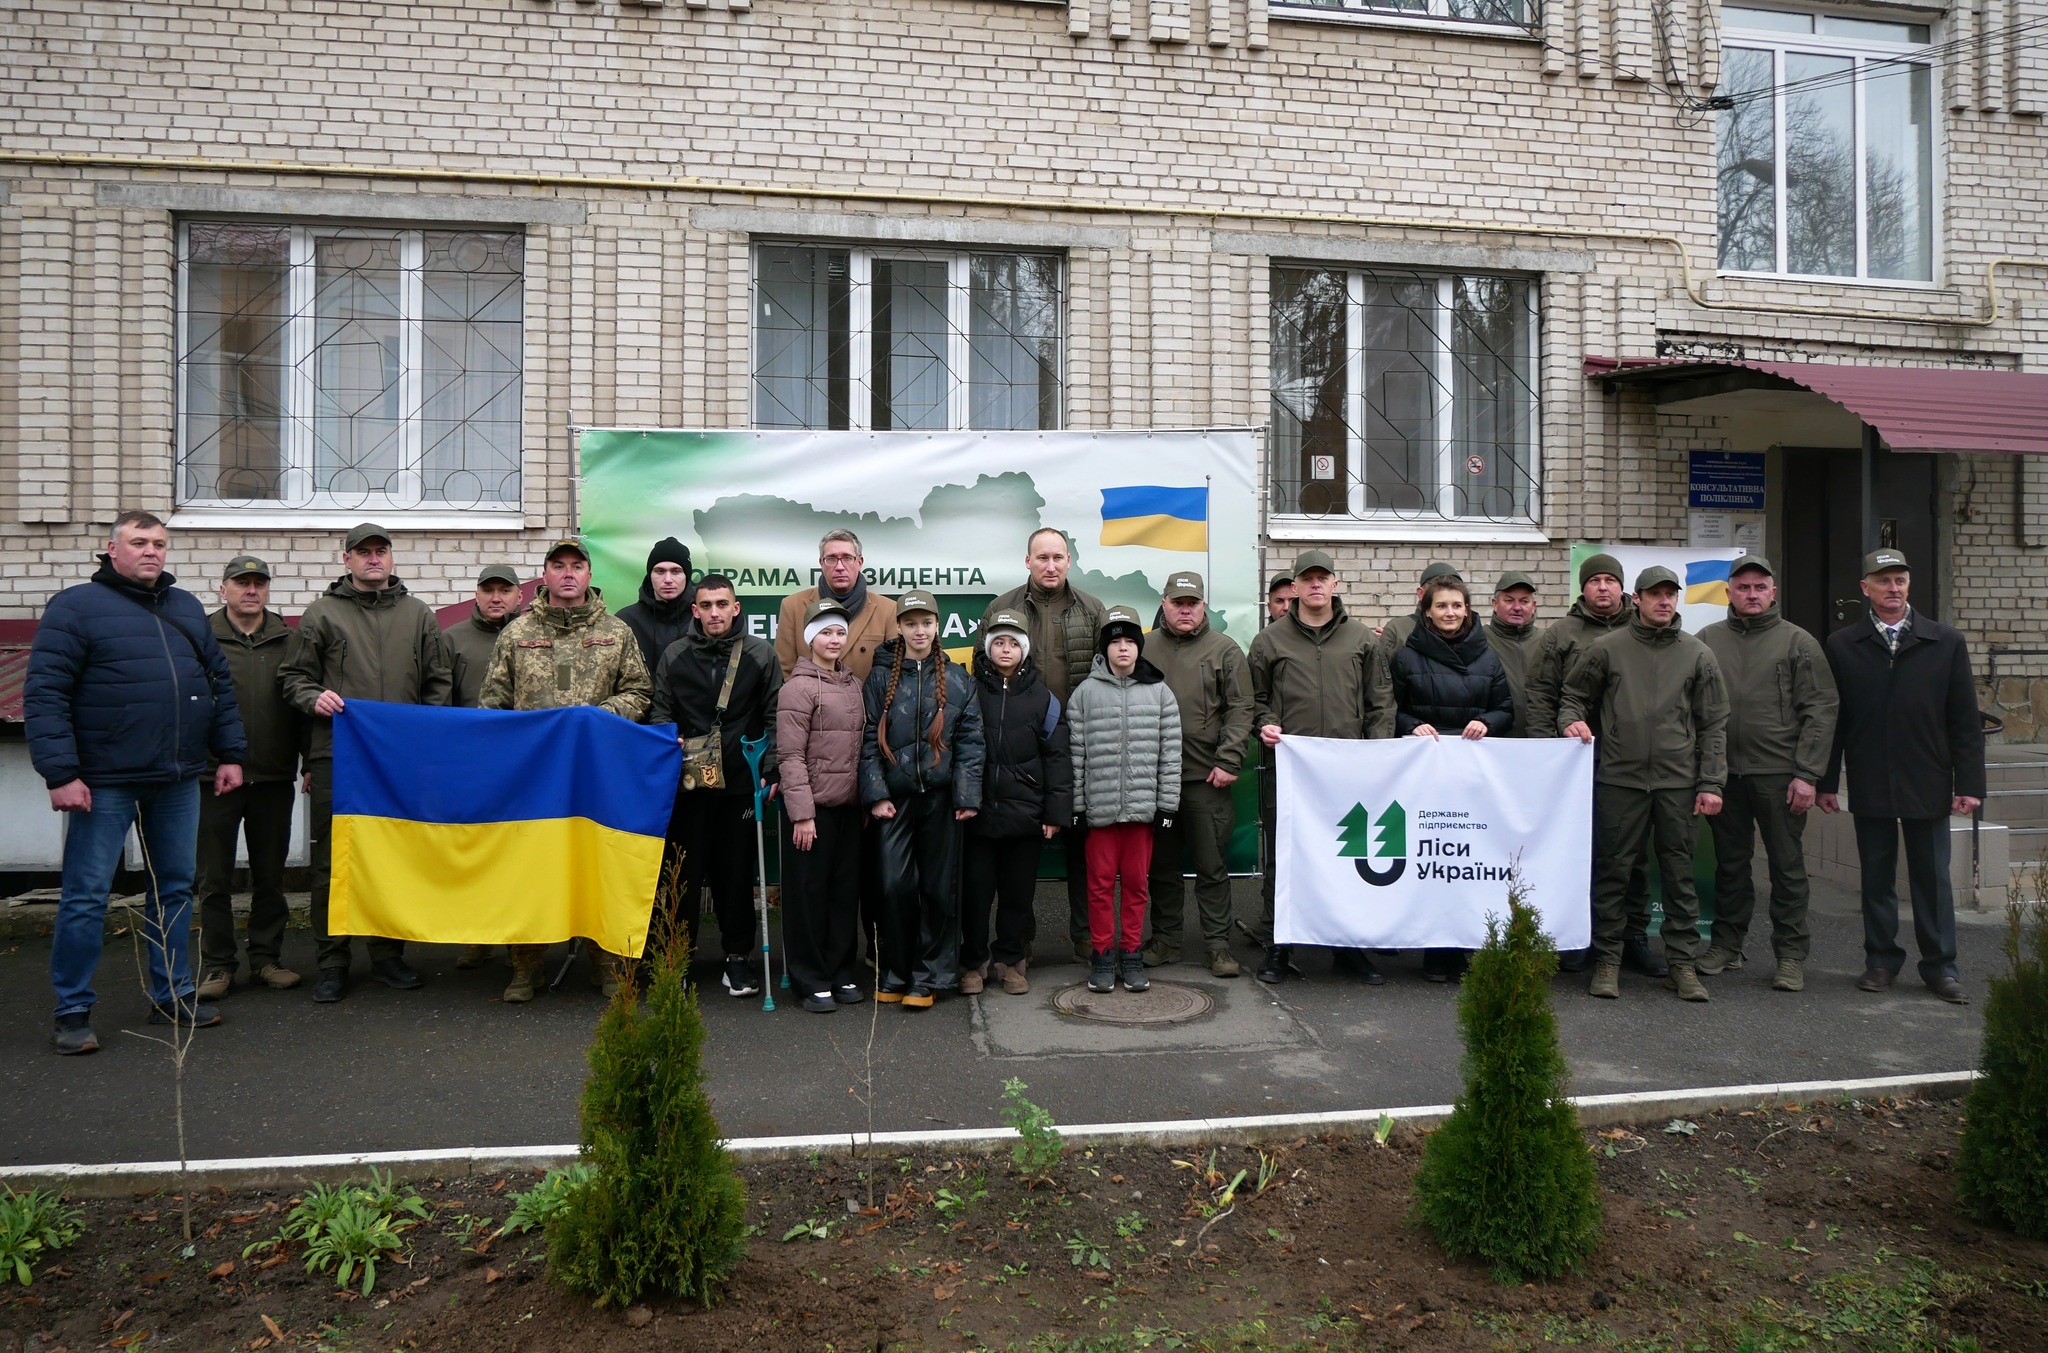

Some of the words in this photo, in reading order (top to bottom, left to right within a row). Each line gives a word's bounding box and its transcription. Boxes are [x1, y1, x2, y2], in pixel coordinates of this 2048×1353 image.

[1690, 483, 1764, 493] КОНСУЛЬТАТИВНА
[1700, 494, 1754, 504] ПОЛІКЛІНІКА
[690, 568, 801, 587] ОГРАМА
[810, 567, 986, 588] ПЗИДЕНТА
[1418, 810, 1469, 819] Державне
[1418, 821, 1488, 830] підприємство
[1417, 838, 1470, 857] Ліси
[1416, 861, 1512, 883] України
